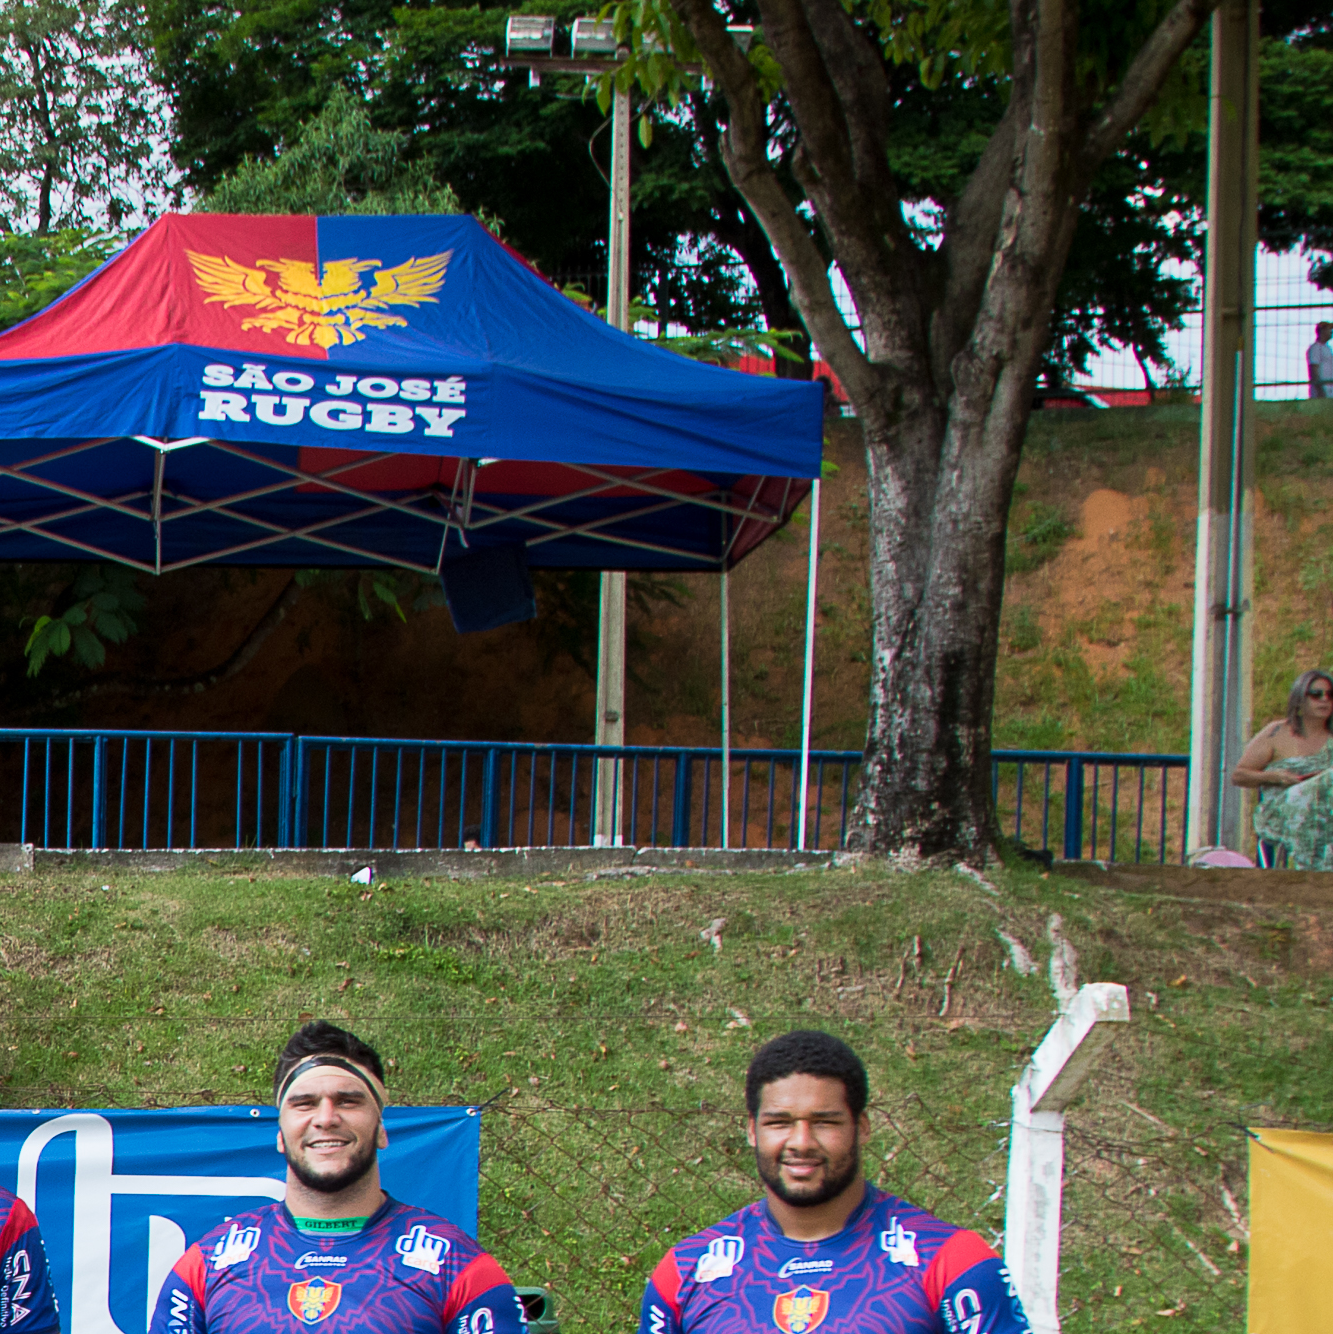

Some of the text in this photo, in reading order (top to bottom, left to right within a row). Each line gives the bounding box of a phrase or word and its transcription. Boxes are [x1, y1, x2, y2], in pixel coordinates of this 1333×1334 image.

[202, 363, 466, 404] SÃO JOSÉ
[198, 391, 466, 437] RUGBY
[303, 1218, 359, 1229] GILBERT
[305, 1254, 348, 1265] SANRAD
[396, 1225, 451, 1264] dm
[789, 1259, 834, 1271] SANRAD
[0, 1284, 10, 1328] Definitivo
[10, 1249, 32, 1327] CNA
[942, 1298, 956, 1332] Inglês
